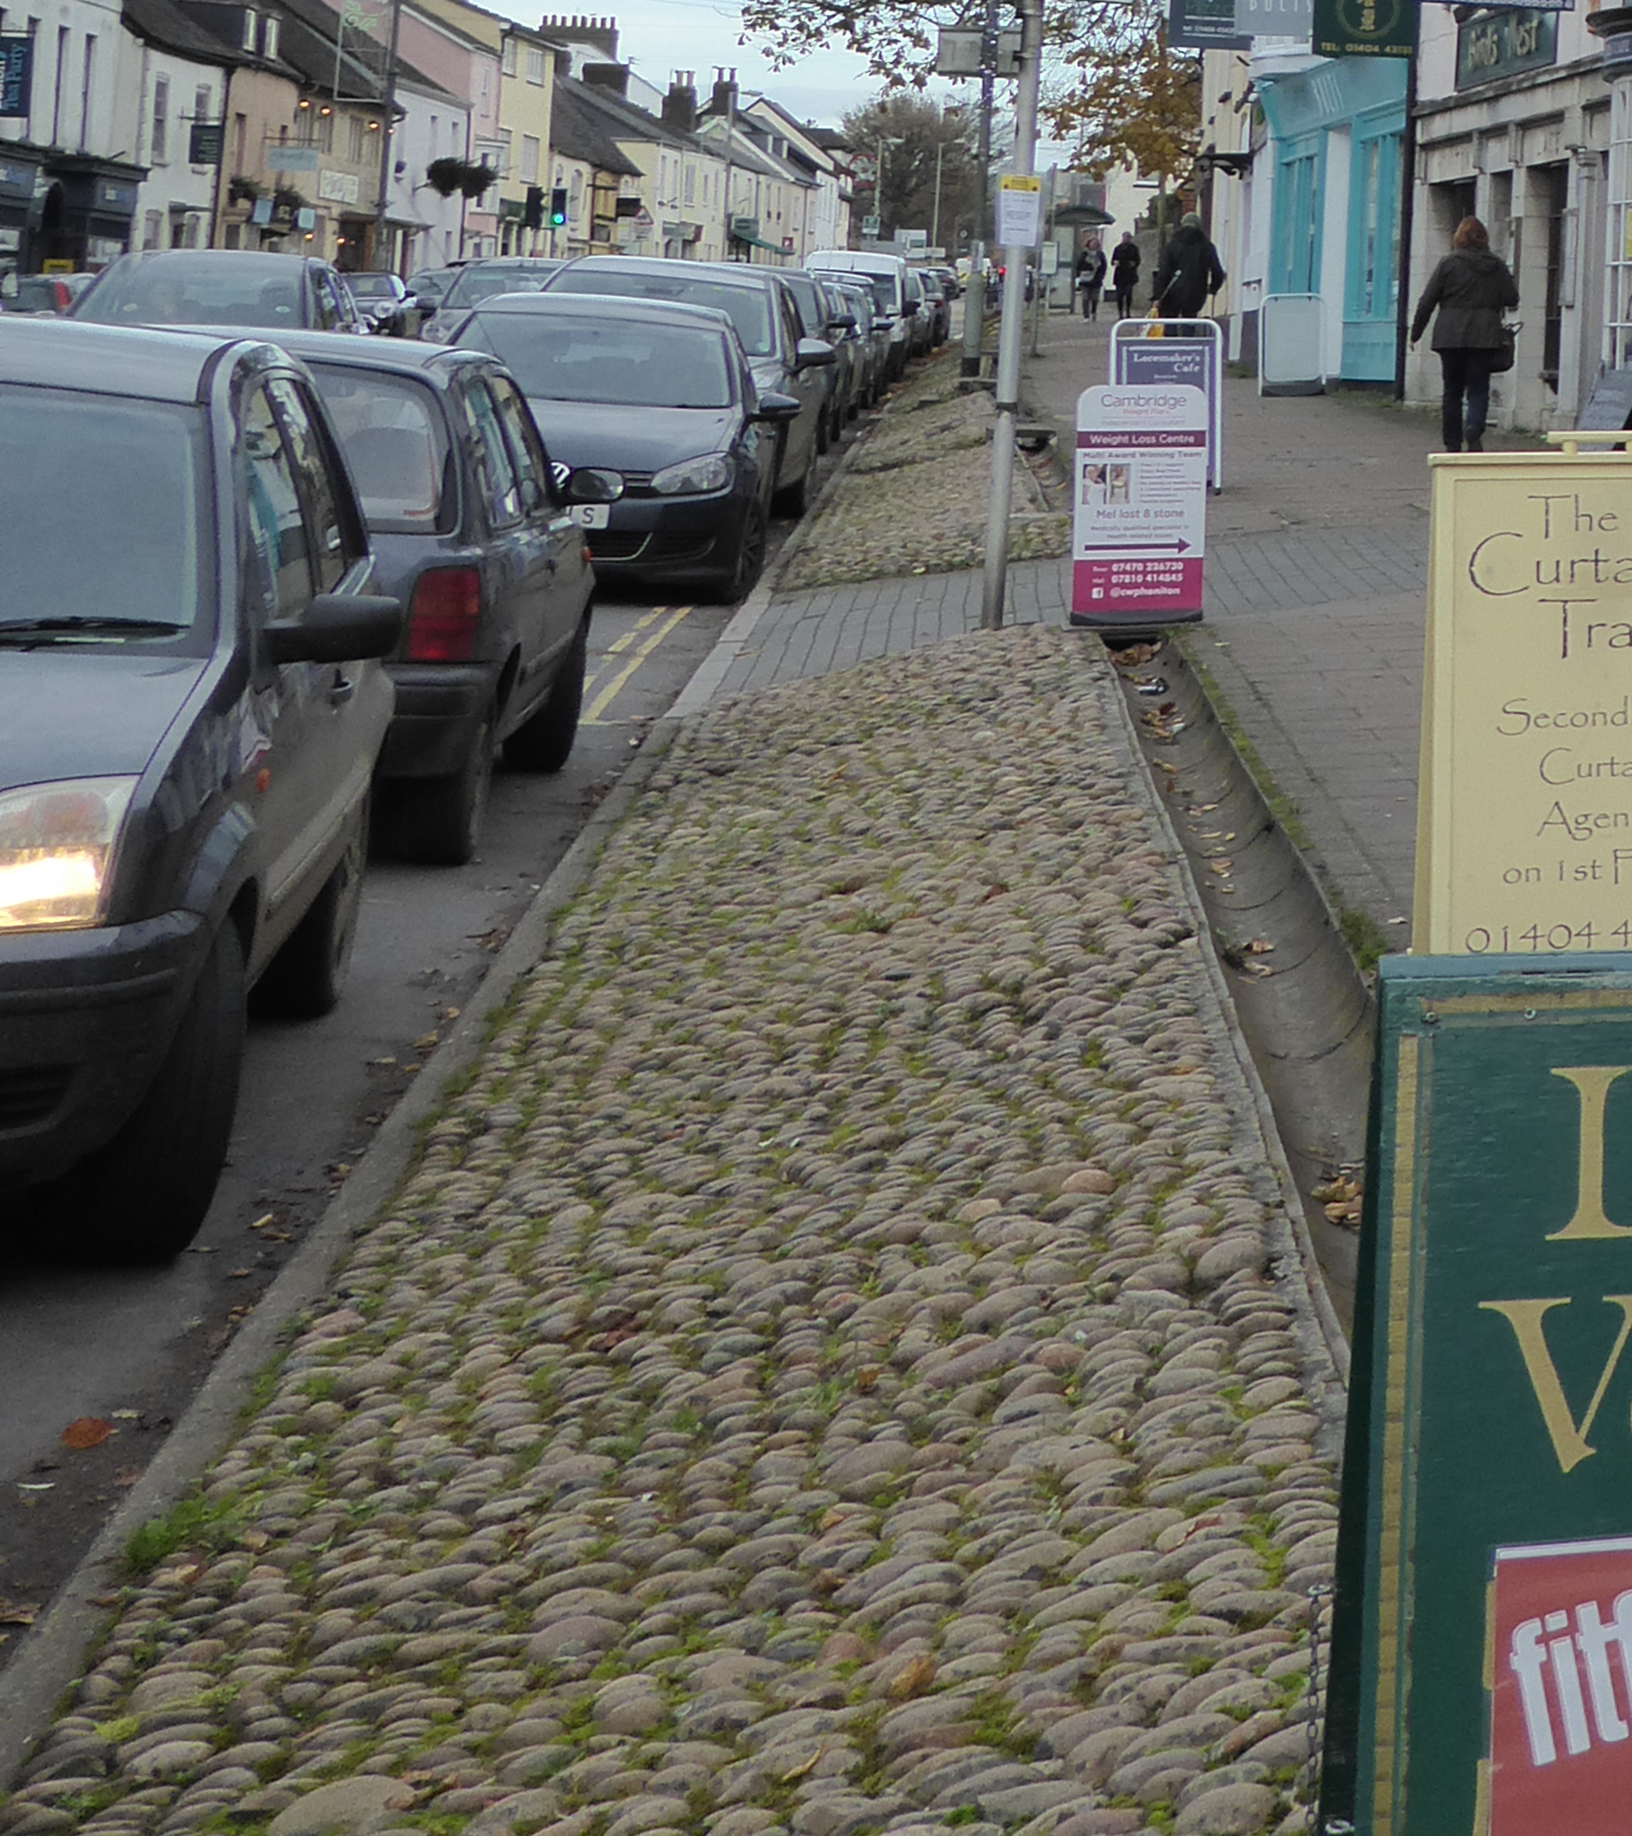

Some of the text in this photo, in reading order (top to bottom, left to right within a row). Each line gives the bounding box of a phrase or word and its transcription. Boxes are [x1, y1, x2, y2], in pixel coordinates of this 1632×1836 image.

[1101, 394, 1187, 410] Cambridge
[1090, 433, 1196, 445] Weight Loss Centre
[1107, 451, 1136, 459] Award
[1138, 451, 1175, 459] Winning
[1096, 508, 1185, 519] Mel lost 8 stone
[1527, 494, 1620, 540] The
[1502, 863, 1542, 885] on
[1557, 858, 1604, 884] 1st
[1464, 921, 1600, 954] 01404
